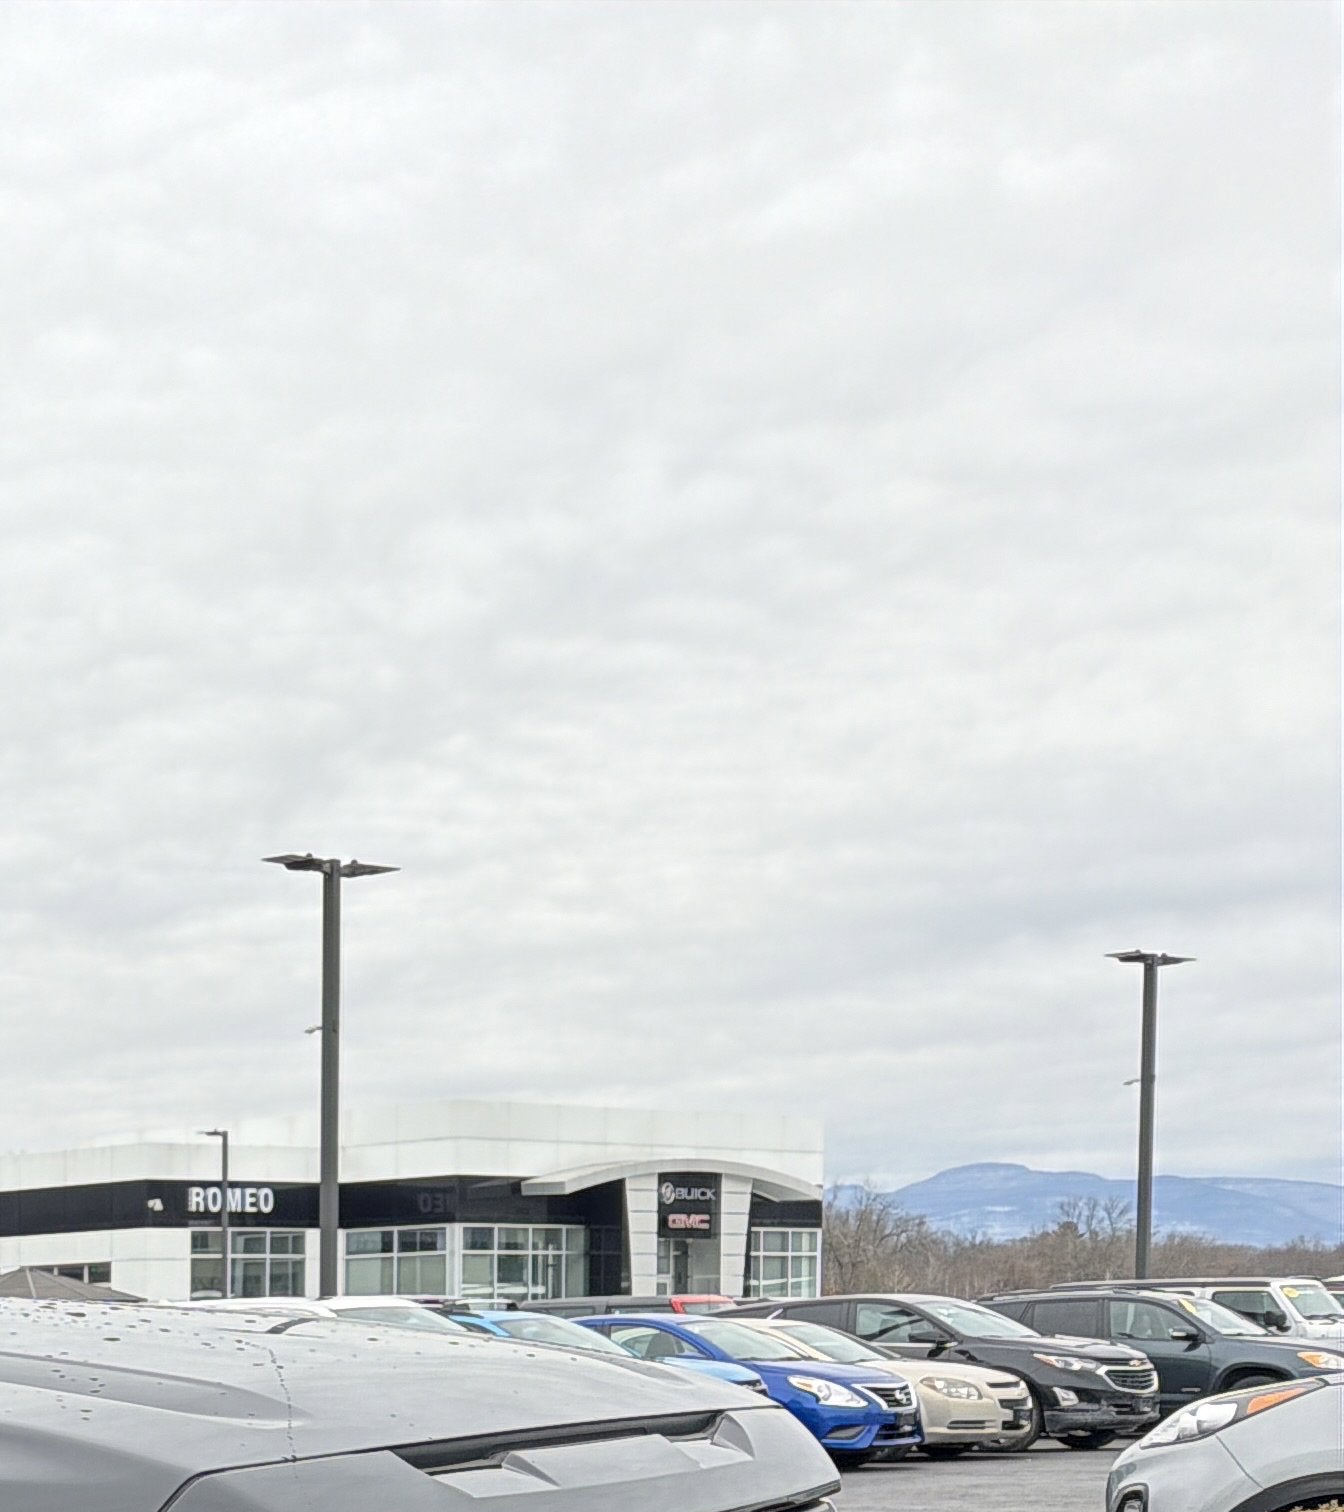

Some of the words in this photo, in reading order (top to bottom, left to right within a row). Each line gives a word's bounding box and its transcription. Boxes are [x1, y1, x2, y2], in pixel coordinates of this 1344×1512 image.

[188, 1186, 274, 1213] ROMEO
[675, 1186, 716, 1200] BUICK
[667, 1213, 710, 1230] GMC
